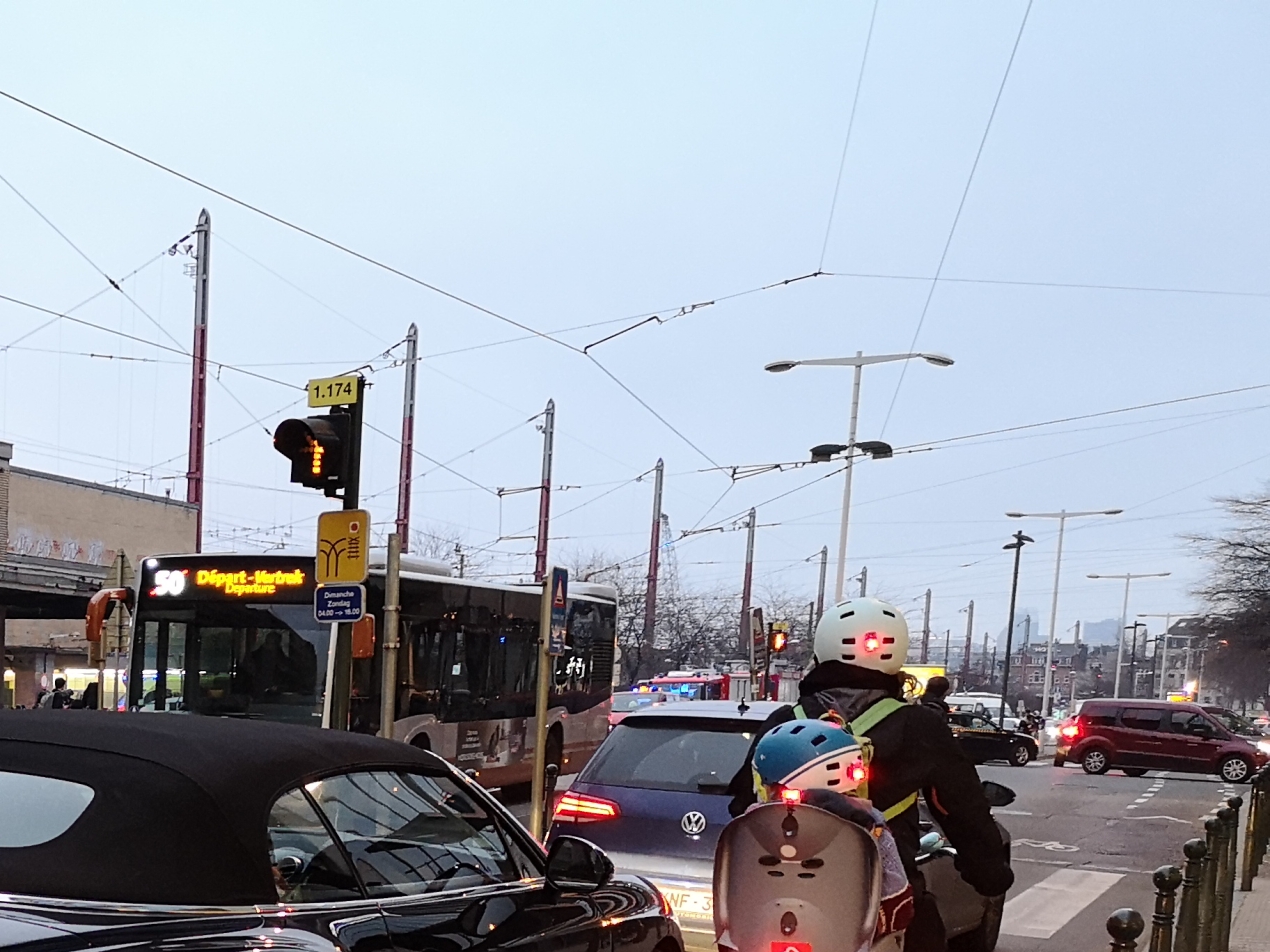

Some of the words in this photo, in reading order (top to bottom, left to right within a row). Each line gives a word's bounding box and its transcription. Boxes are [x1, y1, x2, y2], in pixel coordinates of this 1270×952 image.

[313, 381, 352, 399] 1.174
[154, 570, 185, 596] 50
[197, 569, 245, 587] Départ
[256, 569, 305, 585] Vertrek
[324, 591, 355, 599] Dimanche
[327, 600, 351, 608] Zondag
